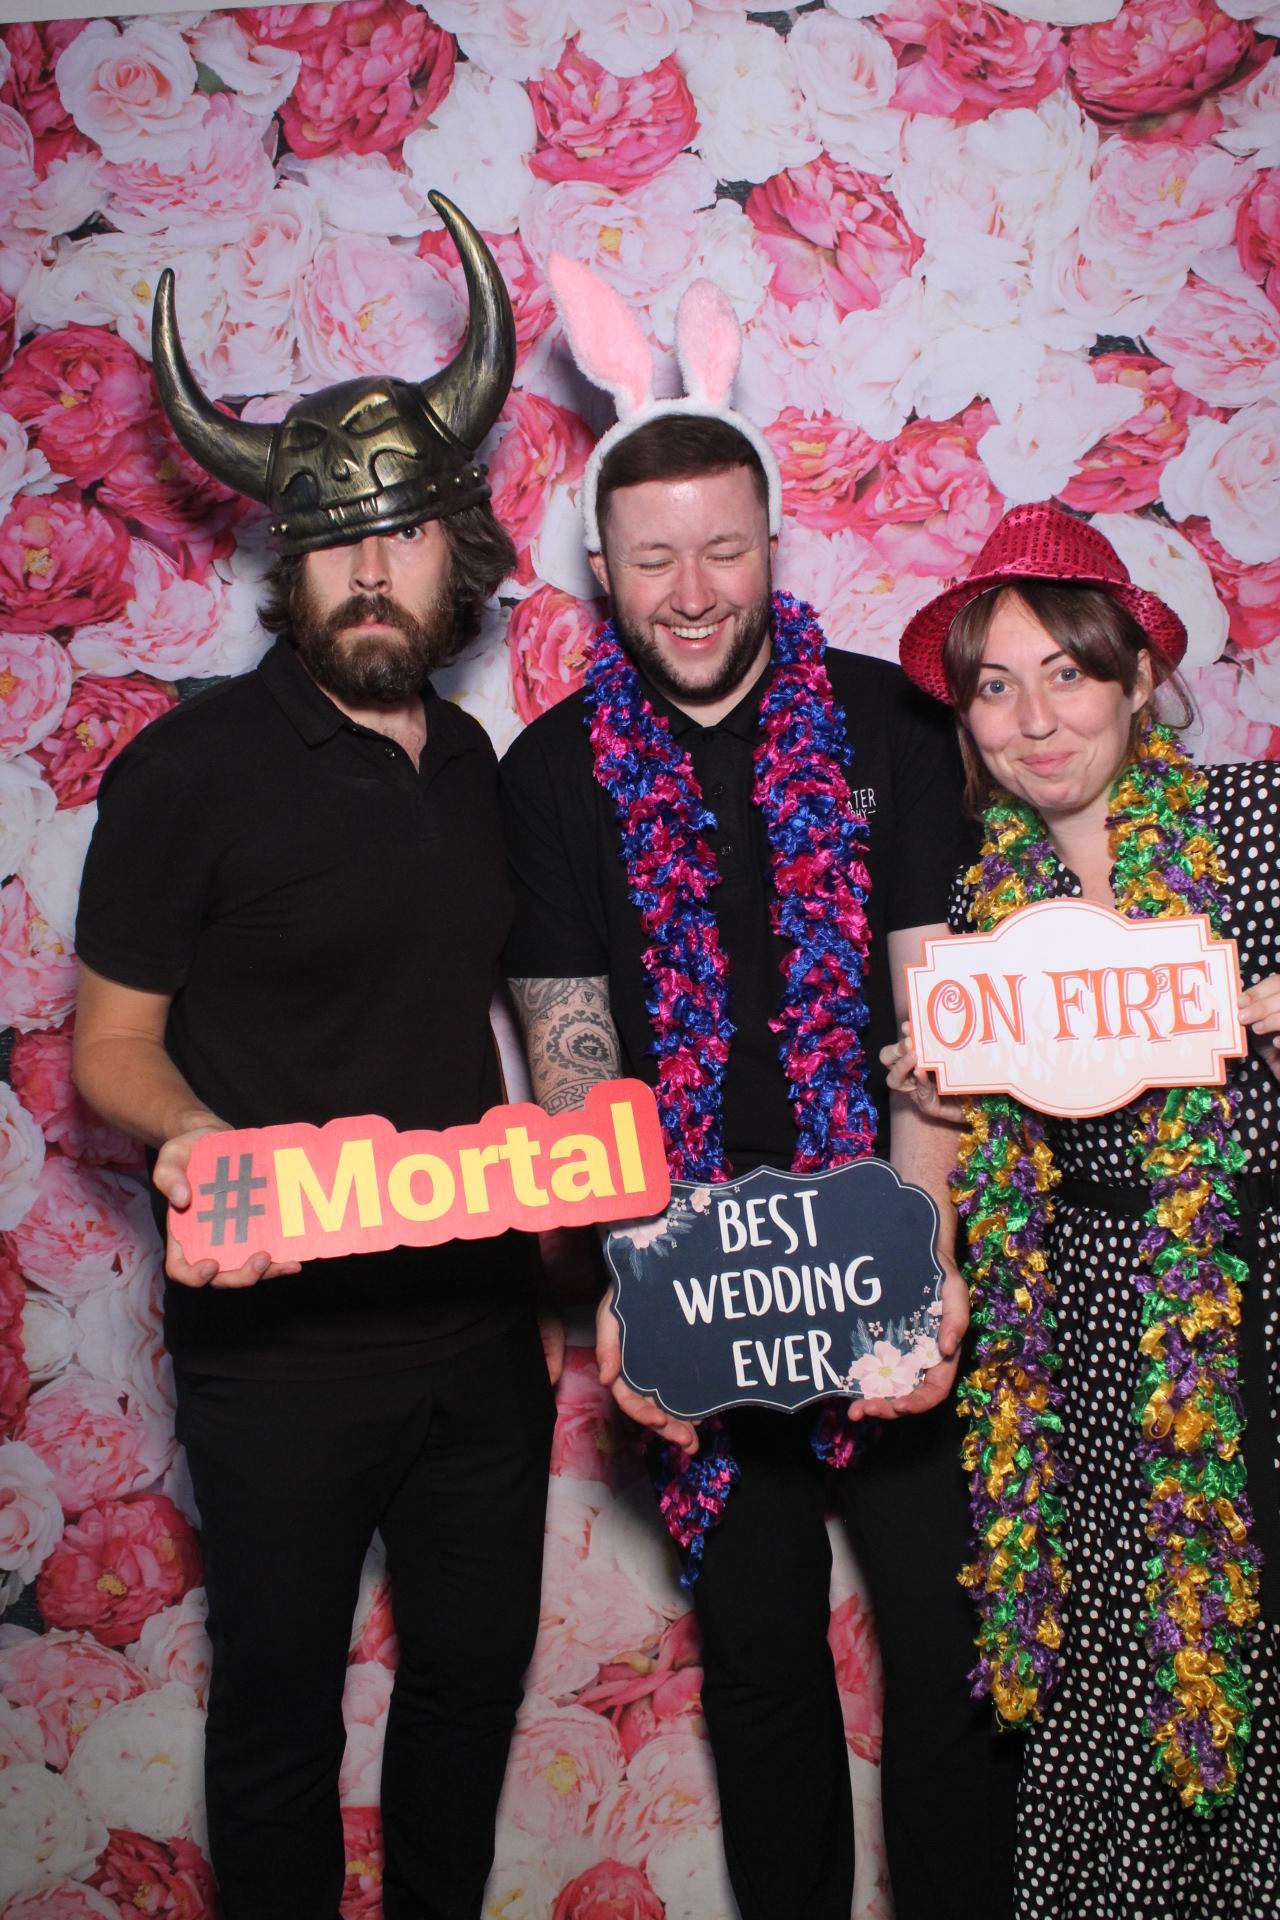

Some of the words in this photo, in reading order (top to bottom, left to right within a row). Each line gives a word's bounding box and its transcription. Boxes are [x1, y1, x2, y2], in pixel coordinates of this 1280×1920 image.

[926, 973, 1027, 1050] ON
[1042, 960, 1219, 1044] FIRE
[197, 1101, 647, 1247] #Mortal
[717, 1190, 818, 1254] BEST
[673, 1255, 882, 1326] WEDDING
[732, 1329, 840, 1391] EVER
